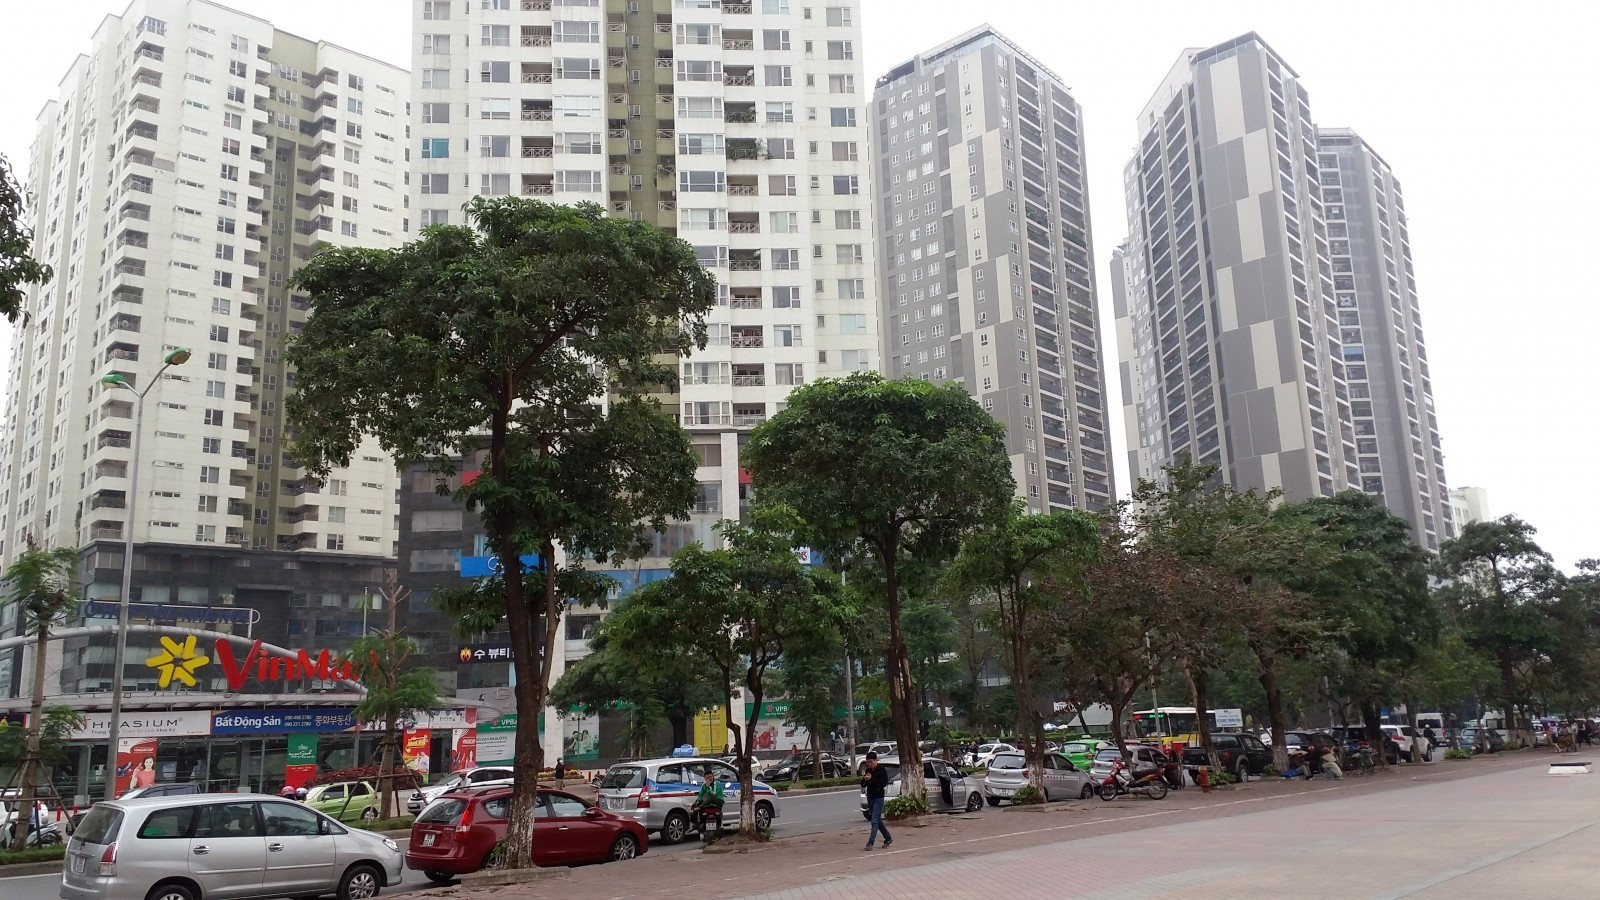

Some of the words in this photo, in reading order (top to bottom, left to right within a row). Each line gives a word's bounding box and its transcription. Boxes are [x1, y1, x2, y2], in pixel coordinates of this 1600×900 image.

[473, 649, 486, 660] 수
[487, 647, 510, 659] 뷰티
[215, 715, 233, 727] Bất
[234, 716, 262, 728] Động
[263, 715, 281, 726] Sản
